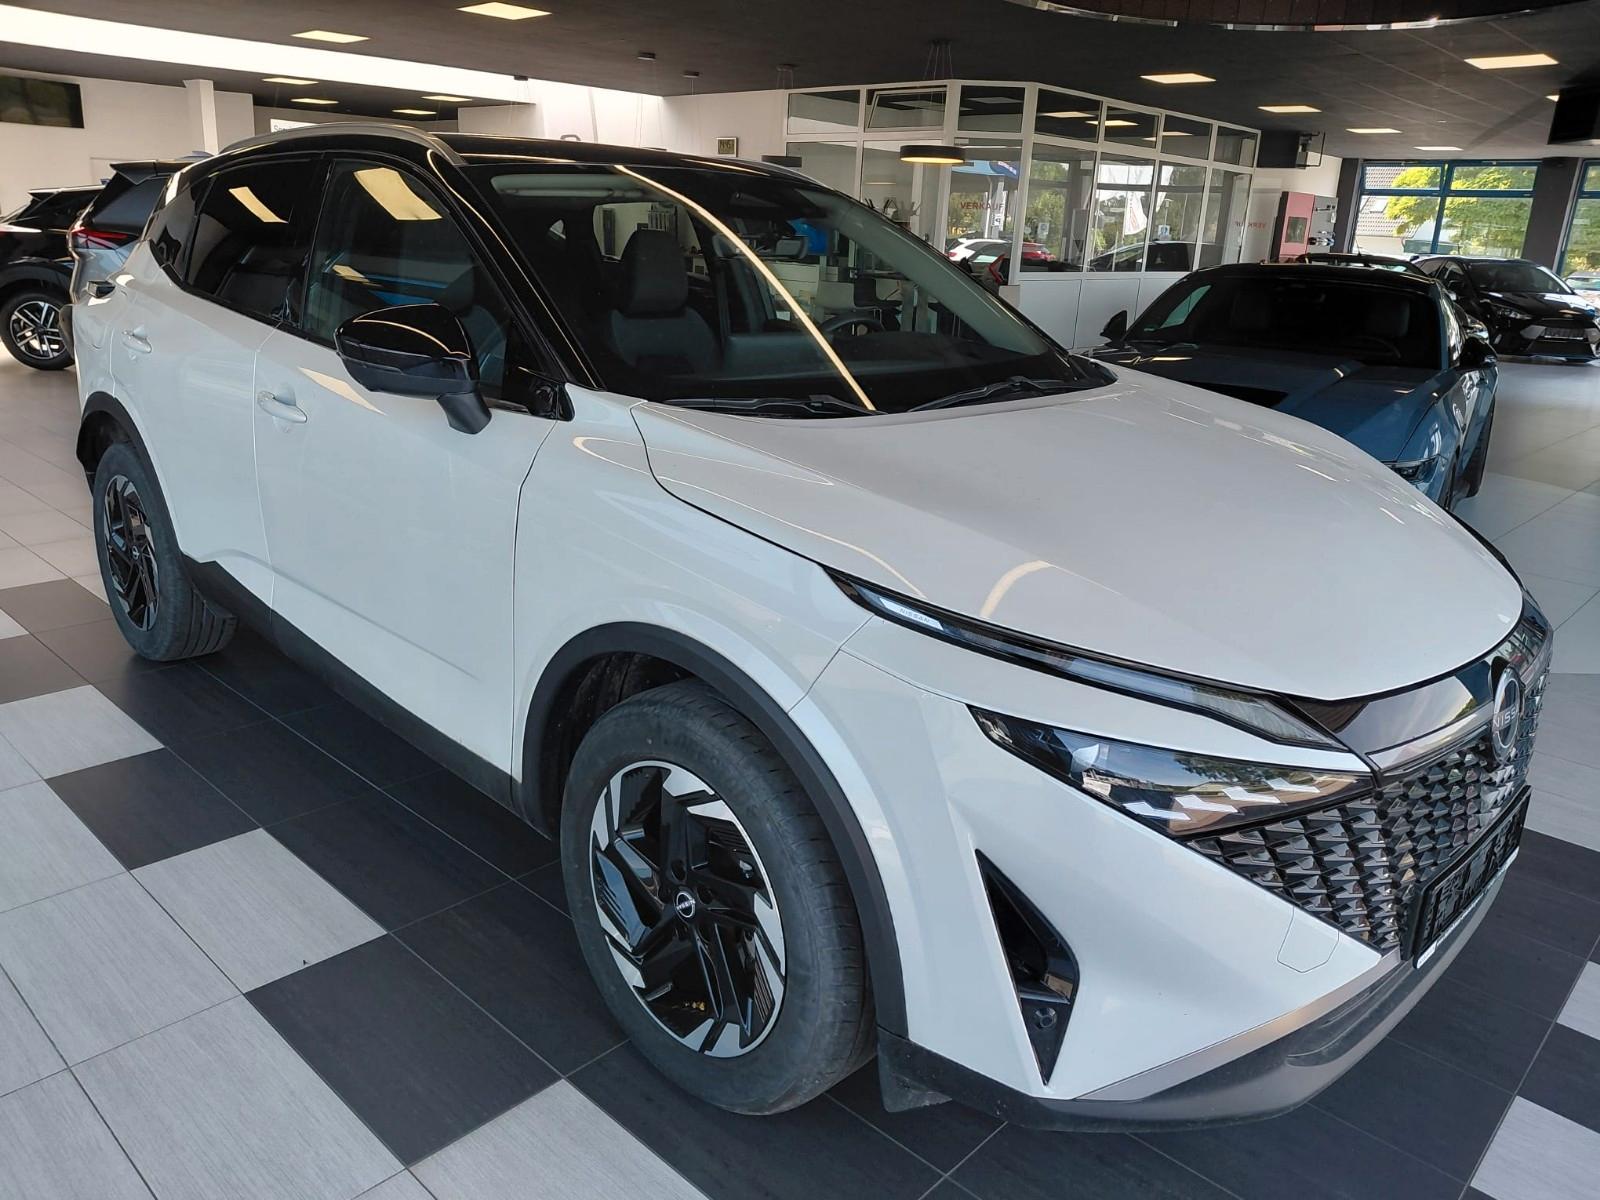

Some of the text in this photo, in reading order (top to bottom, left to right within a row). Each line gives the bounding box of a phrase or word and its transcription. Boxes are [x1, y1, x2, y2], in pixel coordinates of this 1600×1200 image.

[960, 201, 1005, 211] VERKAUF
[900, 608, 930, 623] NISSAN
[1493, 706, 1518, 727] NISS
